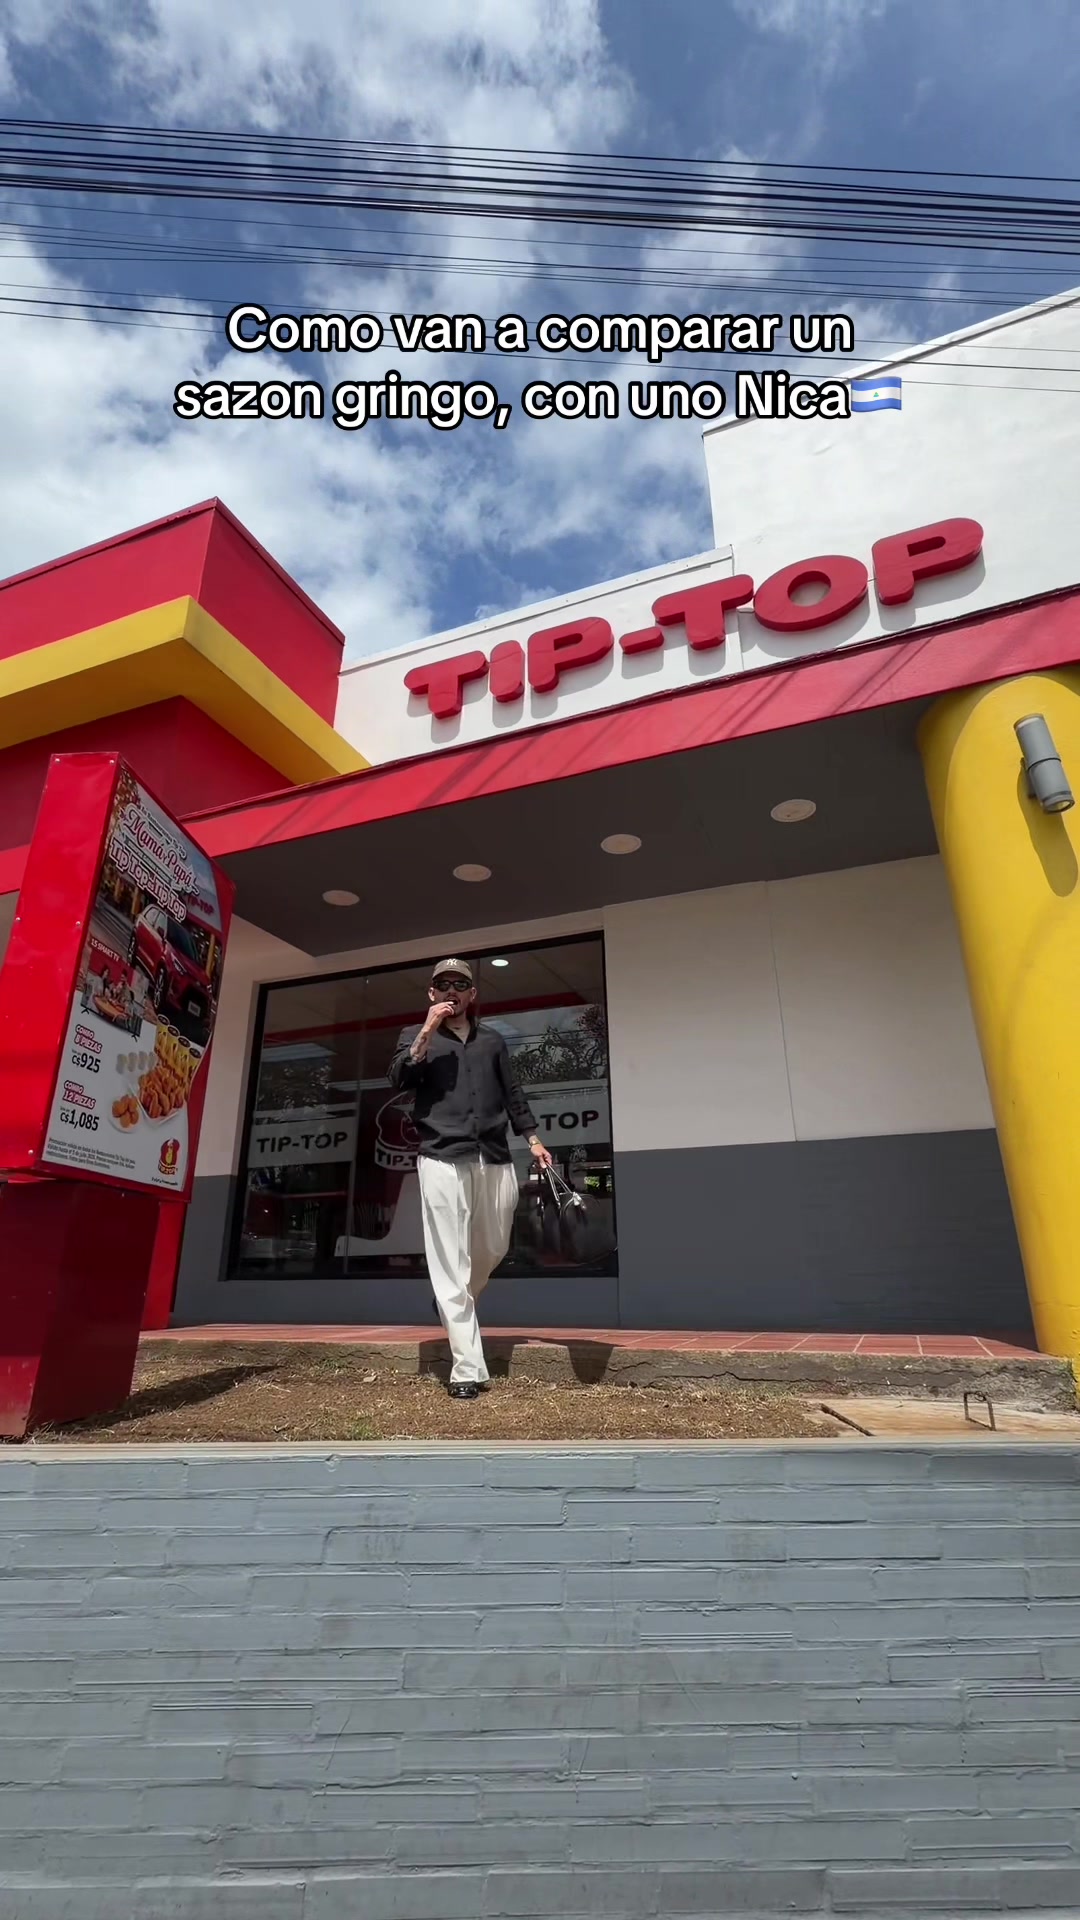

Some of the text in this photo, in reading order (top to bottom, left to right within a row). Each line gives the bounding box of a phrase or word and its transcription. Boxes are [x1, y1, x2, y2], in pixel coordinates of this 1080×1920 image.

[404, 517, 984, 720] TIP-TOP
[123, 809, 166, 860] Mamá
[166, 849, 195, 887] Papá
[111, 837, 129, 868] Tip
[129, 854, 149, 888] Top
[154, 877, 168, 907] Tip
[167, 889, 187, 921] Top
[80, 1036, 102, 1053] PIEZAS
[64, 1091, 74, 1102] 12
[74, 1093, 96, 1109] PIEZAS
[537, 1110, 599, 1131] TOP
[256, 1132, 348, 1153] TIP-TOP
[376, 1148, 417, 1168] TIP-T
